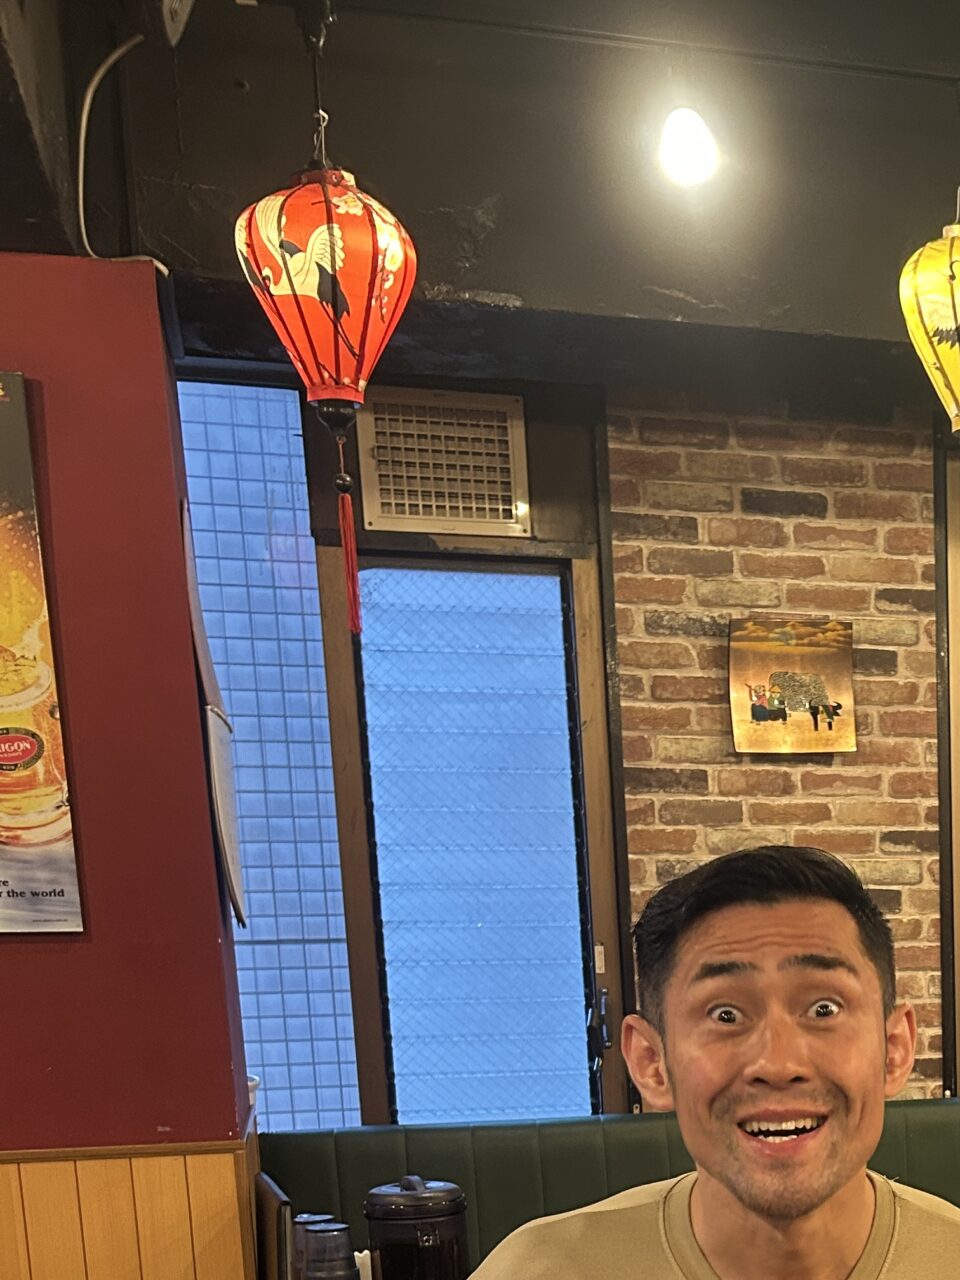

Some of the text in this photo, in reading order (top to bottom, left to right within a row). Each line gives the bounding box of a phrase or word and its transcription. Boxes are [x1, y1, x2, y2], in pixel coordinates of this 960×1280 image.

[0, 740, 31, 752] IGON
[6, 889, 26, 898] the
[30, 888, 65, 897] world
